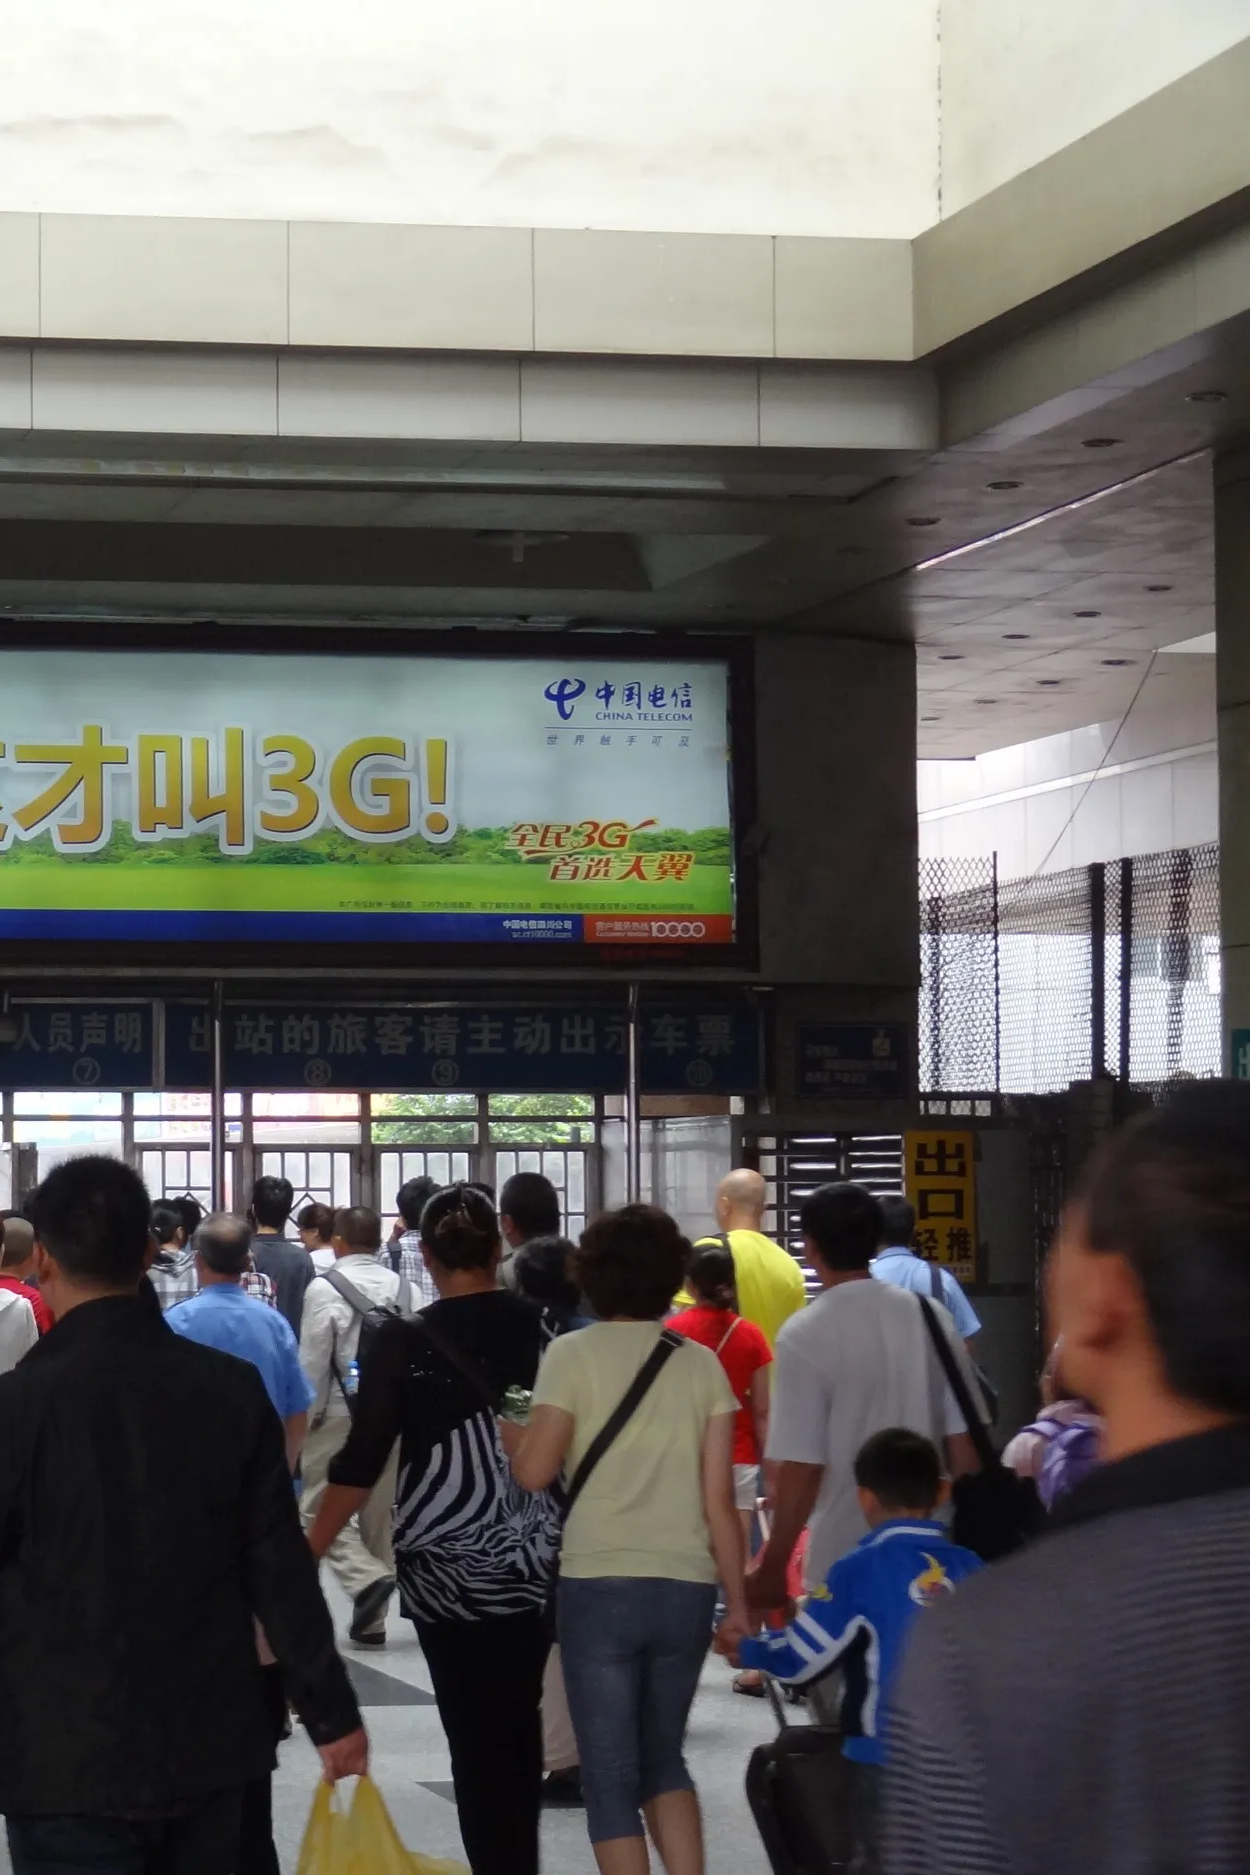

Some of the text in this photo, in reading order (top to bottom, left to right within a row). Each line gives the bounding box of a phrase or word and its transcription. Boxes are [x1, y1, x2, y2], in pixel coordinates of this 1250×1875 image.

[595, 680, 693, 710] 中国电信
[595, 712, 693, 722] CHINA TELECOM
[506, 820, 634, 849] 全民3G
[550, 853, 692, 882] 首选天翼
[650, 921, 706, 938] 10000
[915, 1138, 967, 1221] 出口
[910, 1226, 973, 1262] 轻推
